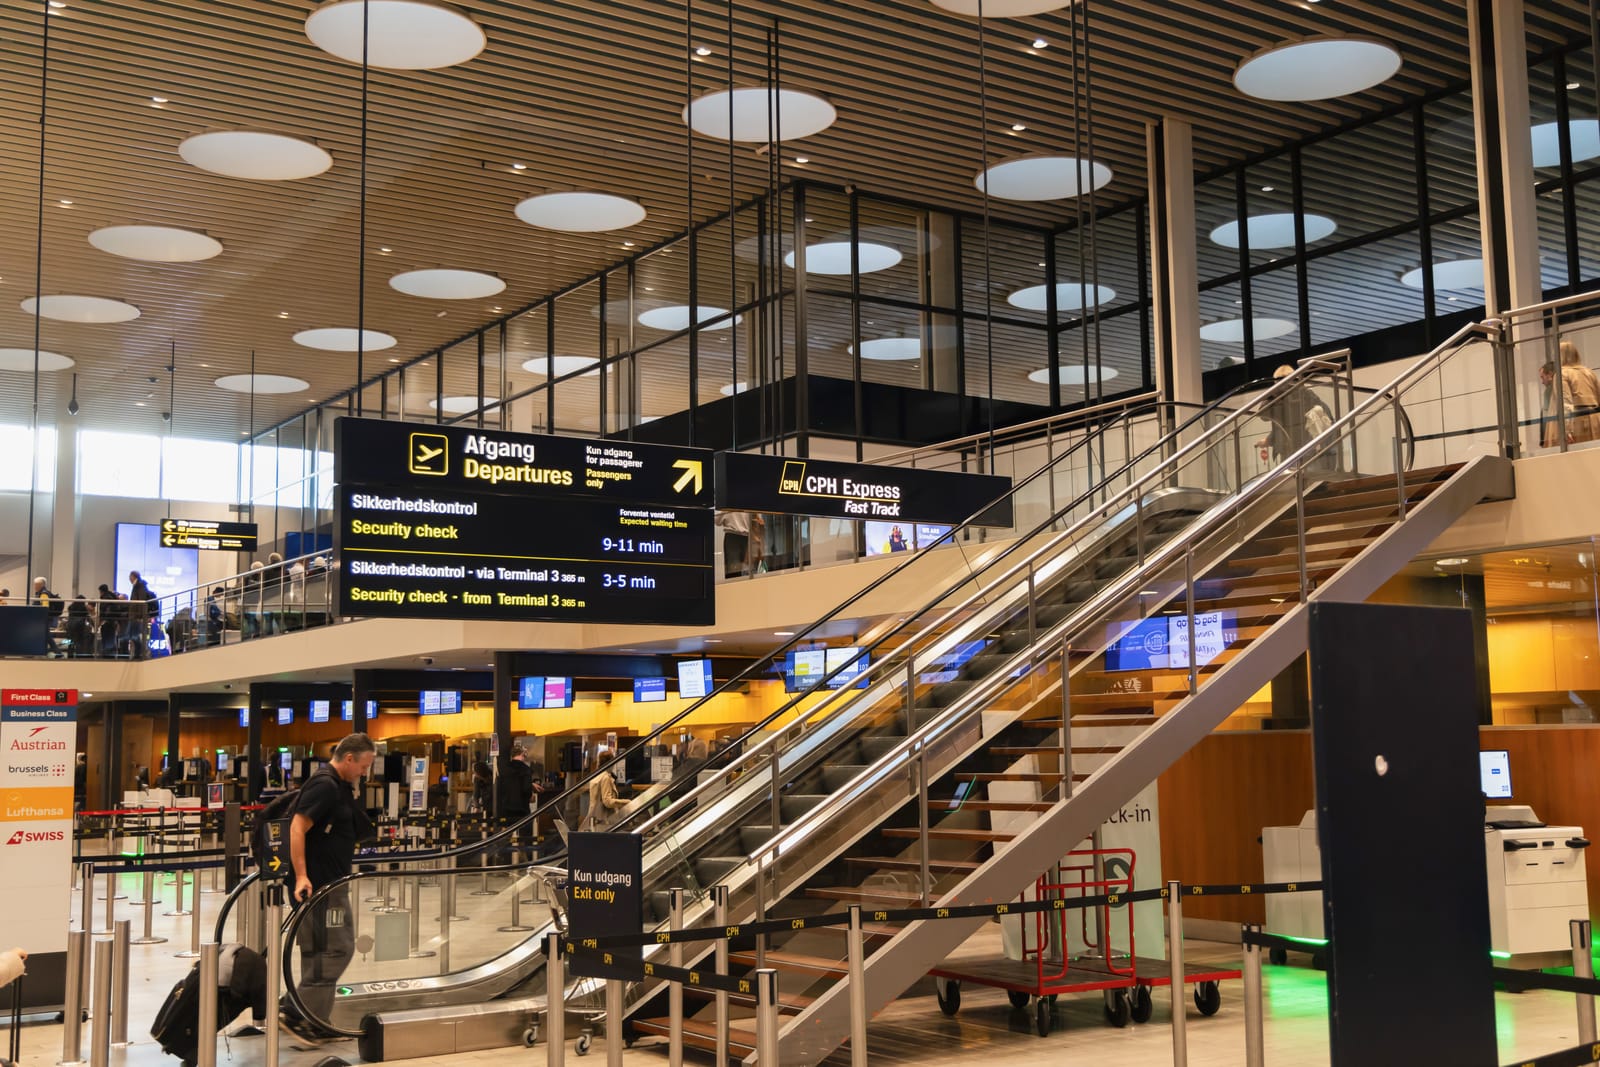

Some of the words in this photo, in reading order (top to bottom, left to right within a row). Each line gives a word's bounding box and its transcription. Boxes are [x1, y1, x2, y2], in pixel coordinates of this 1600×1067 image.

[464, 435, 535, 463] Afgang
[586, 446, 601, 455] Kun
[604, 449, 633, 459] adgang
[586, 455, 598, 464] for
[600, 458, 643, 468] passagerer
[464, 458, 573, 485] Departures
[586, 469, 632, 480] Passengers
[586, 479, 604, 489] only
[783, 480, 799, 491] CPH
[806, 476, 837, 494] CPH
[843, 479, 900, 499] Express
[352, 494, 478, 515] Sikkerhedskontrol
[844, 500, 868, 514] Fast
[871, 502, 900, 516] Track
[352, 520, 411, 539] Security
[415, 524, 458, 538] check
[651, 520, 673, 528] waiting
[603, 538, 634, 552] 9-11
[639, 541, 663, 553] min
[351, 561, 465, 578] Sikkerhedskontrol
[476, 567, 495, 579] via
[497, 567, 548, 582] Terminal
[551, 570, 560, 582] 3
[561, 574, 576, 582] 365
[603, 573, 627, 588] 3-5
[631, 576, 656, 589] min
[351, 587, 405, 605] Security
[409, 590, 448, 603] check
[463, 592, 492, 604] from
[497, 592, 548, 607] Terminal
[551, 595, 560, 607] 3
[561, 599, 576, 607] 365
[11, 693, 29, 701] First
[30, 693, 51, 701] Class
[11, 739, 66, 750] Austrian
[8, 765, 49, 773] brussels
[6, 807, 64, 817] Lufthansa
[25, 831, 64, 841] SWISS
[574, 869, 592, 882] Kun
[595, 870, 632, 887] udgang
[574, 886, 592, 899] Exit
[595, 888, 615, 903] only
[1108, 895, 1119, 904] CPH
[996, 905, 1008, 914] CPH
[1053, 900, 1065, 909] CPH
[874, 912, 887, 921] CPH
[937, 909, 949, 917] CPH
[792, 920, 805, 929] CPH
[726, 927, 740, 936] CPH
[656, 934, 671, 943] CPH
[689, 972, 700, 984] CPH
[739, 981, 750, 992] CPH
